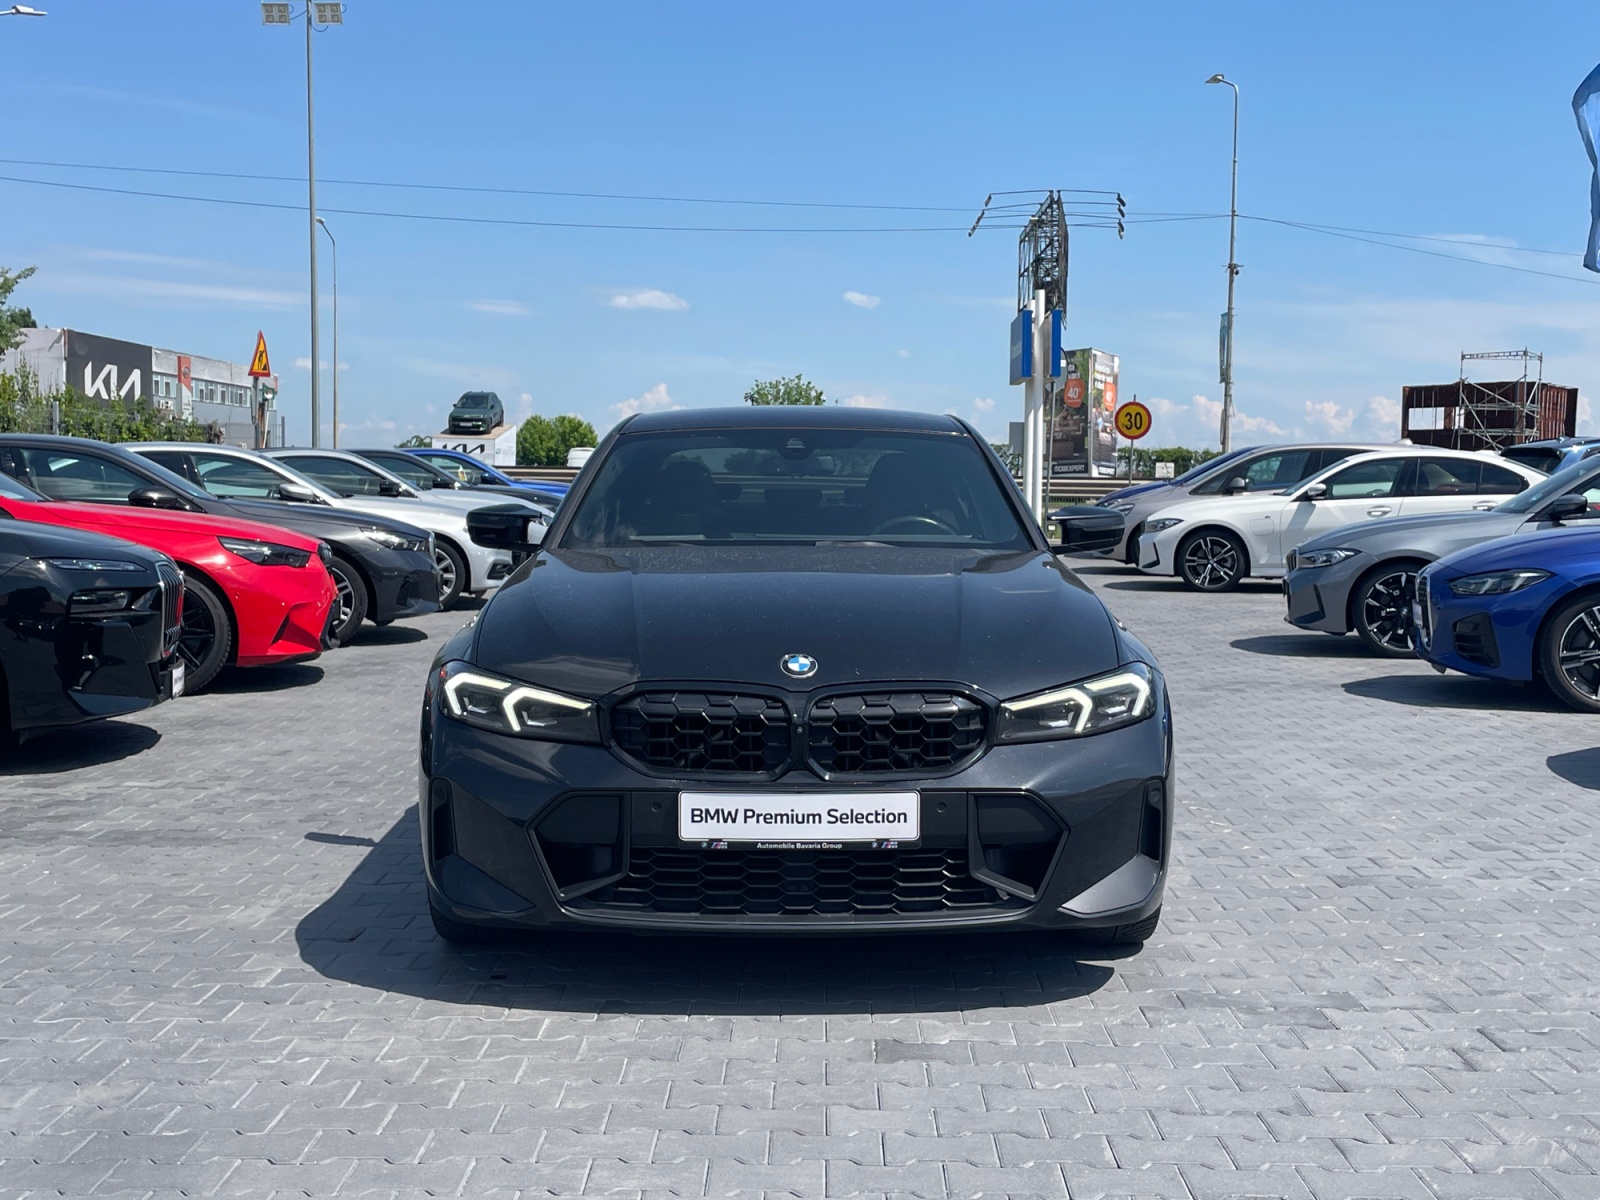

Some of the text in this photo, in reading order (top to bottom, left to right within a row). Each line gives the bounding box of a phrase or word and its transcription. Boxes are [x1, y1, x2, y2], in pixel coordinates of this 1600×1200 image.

[84, 360, 142, 401] KIA
[1124, 411, 1143, 431] 30
[690, 808, 908, 825] BMW Premium Selection
[821, 842, 843, 850] Group
